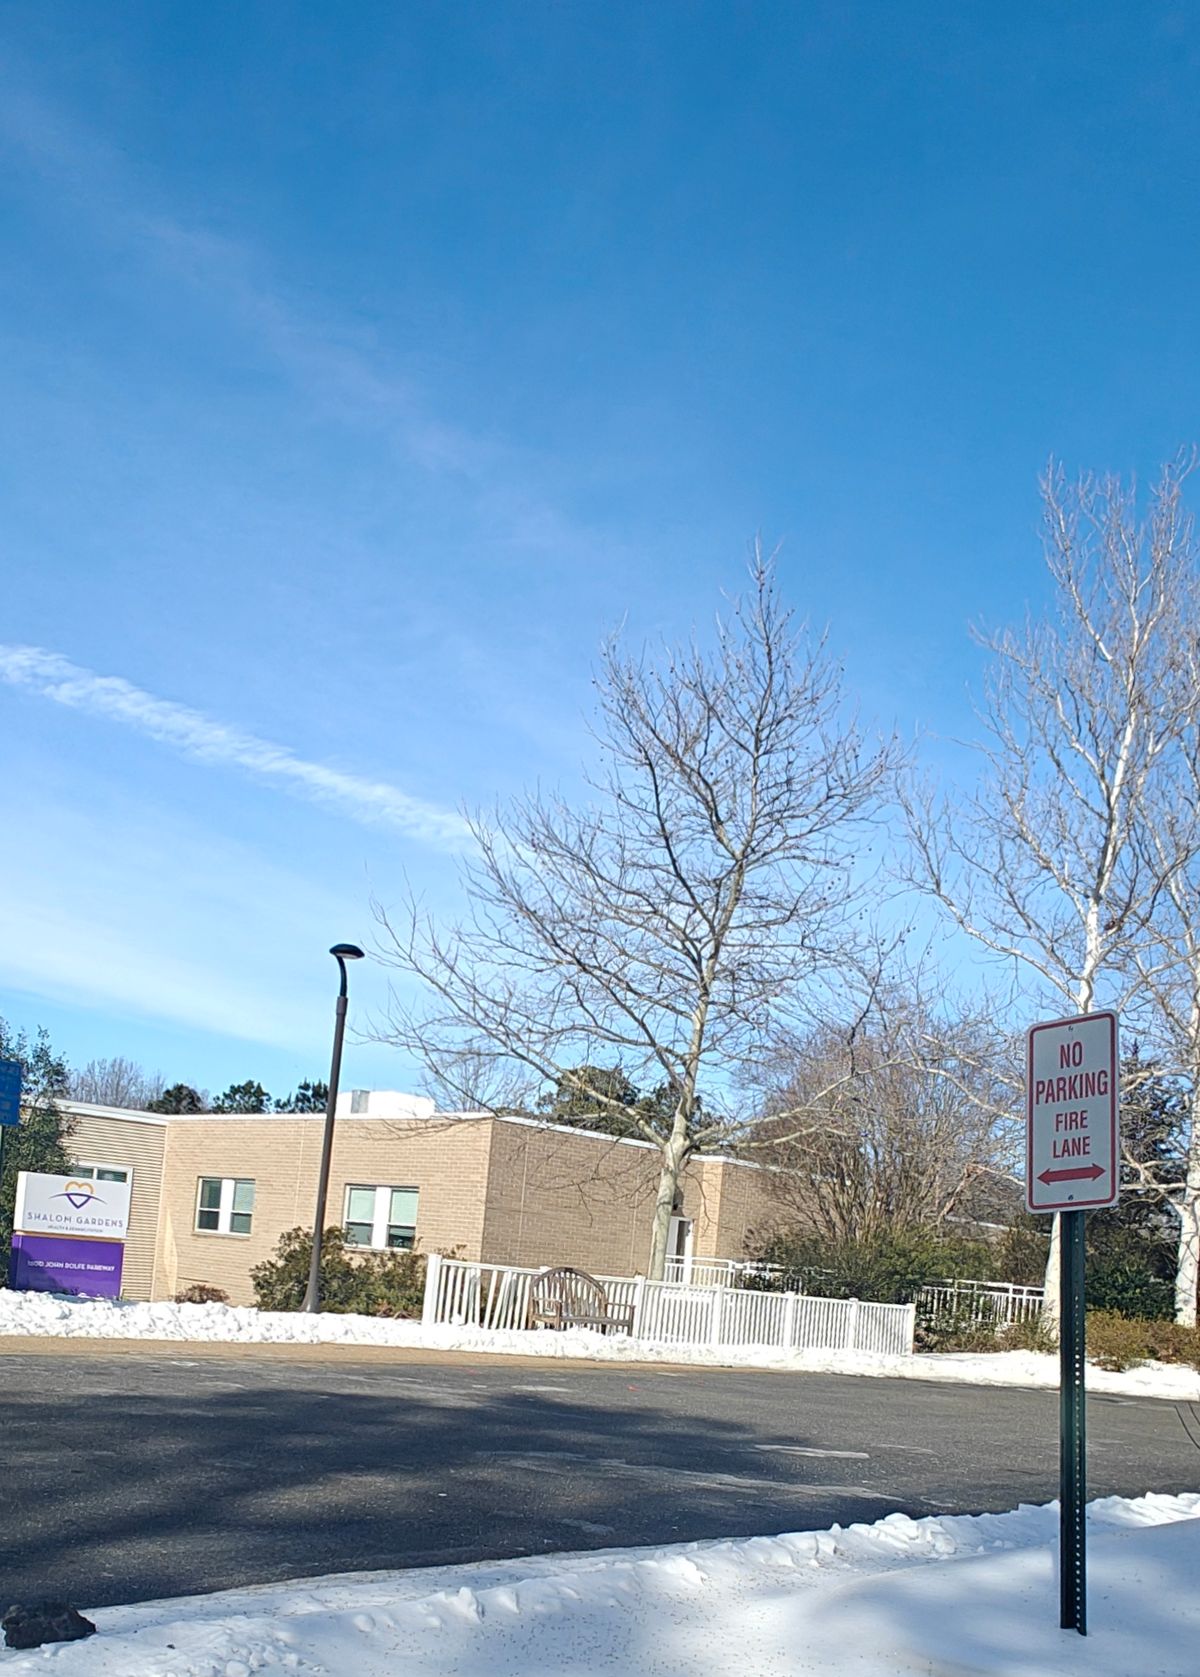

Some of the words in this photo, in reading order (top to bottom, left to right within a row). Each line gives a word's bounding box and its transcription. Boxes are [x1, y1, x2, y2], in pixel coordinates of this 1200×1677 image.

[1059, 1041, 1083, 1069] NO
[1035, 1070, 1109, 1105] PARKING
[1055, 1110, 1089, 1132] FIRE
[1052, 1136, 1091, 1159] LANE
[27, 1211, 72, 1223] SHALOM
[76, 1216, 124, 1228] GARDENS
